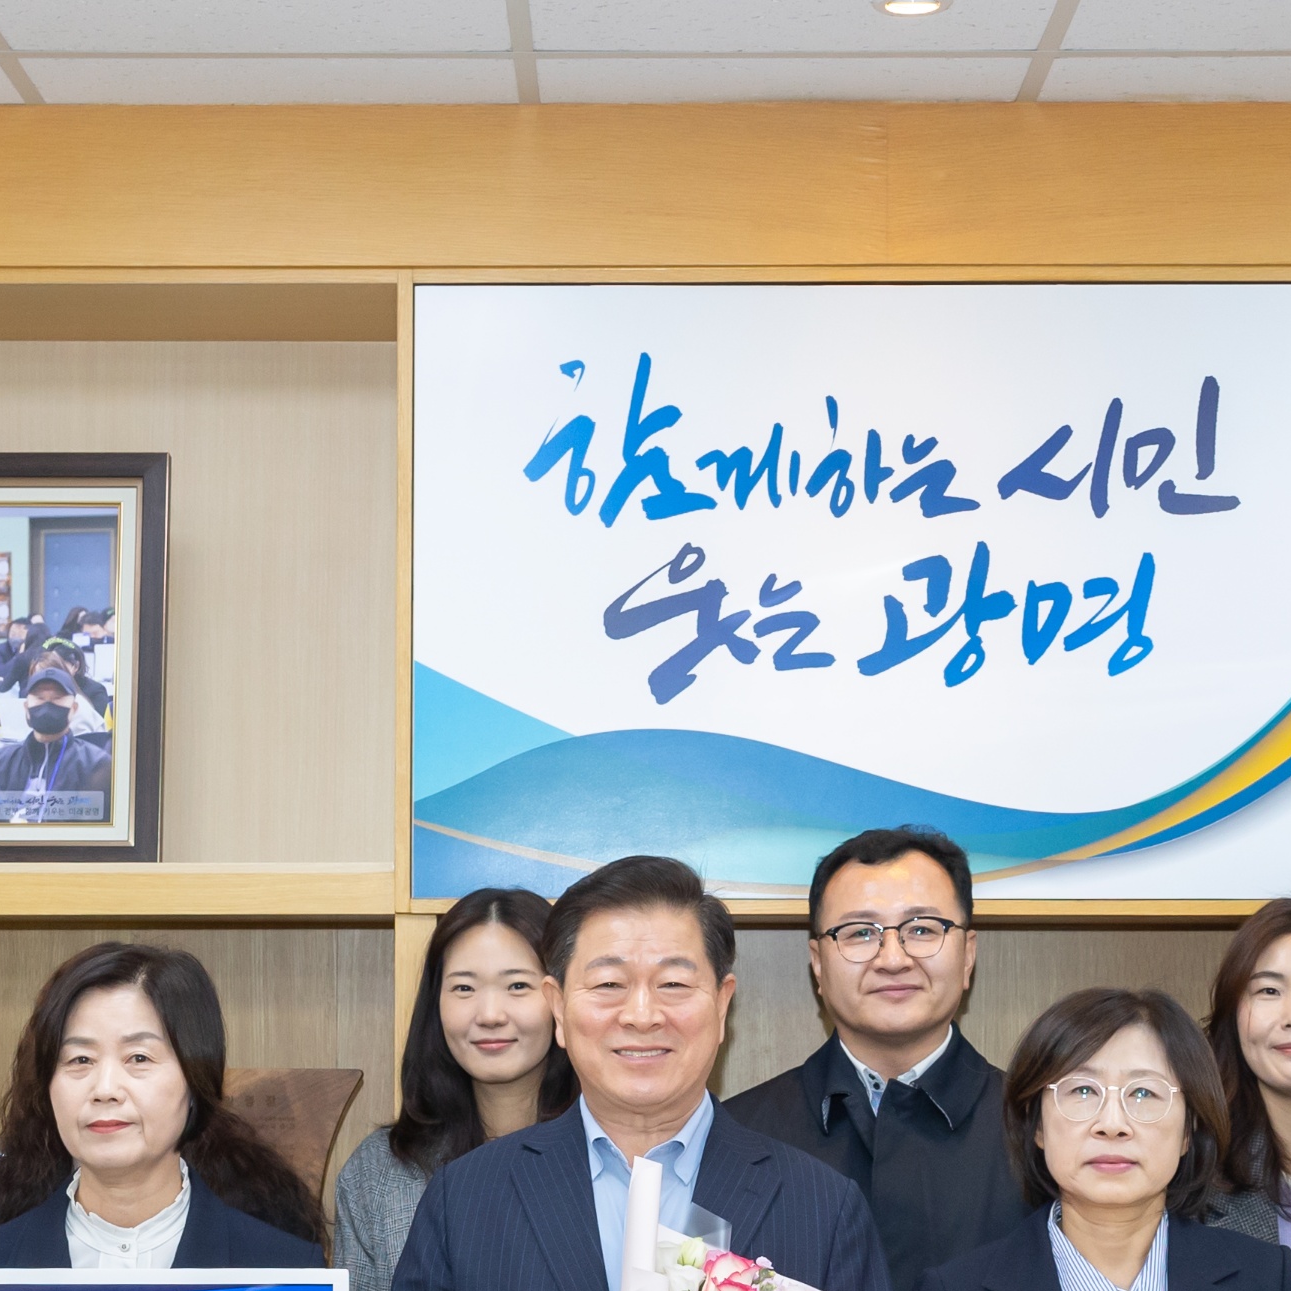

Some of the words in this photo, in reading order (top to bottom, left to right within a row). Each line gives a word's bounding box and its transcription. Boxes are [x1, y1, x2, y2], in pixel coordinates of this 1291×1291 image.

[523, 351, 981, 529] 함께하는
[997, 375, 1242, 518] 시민
[603, 542, 836, 706] 웃는
[857, 540, 1158, 688] 광명
